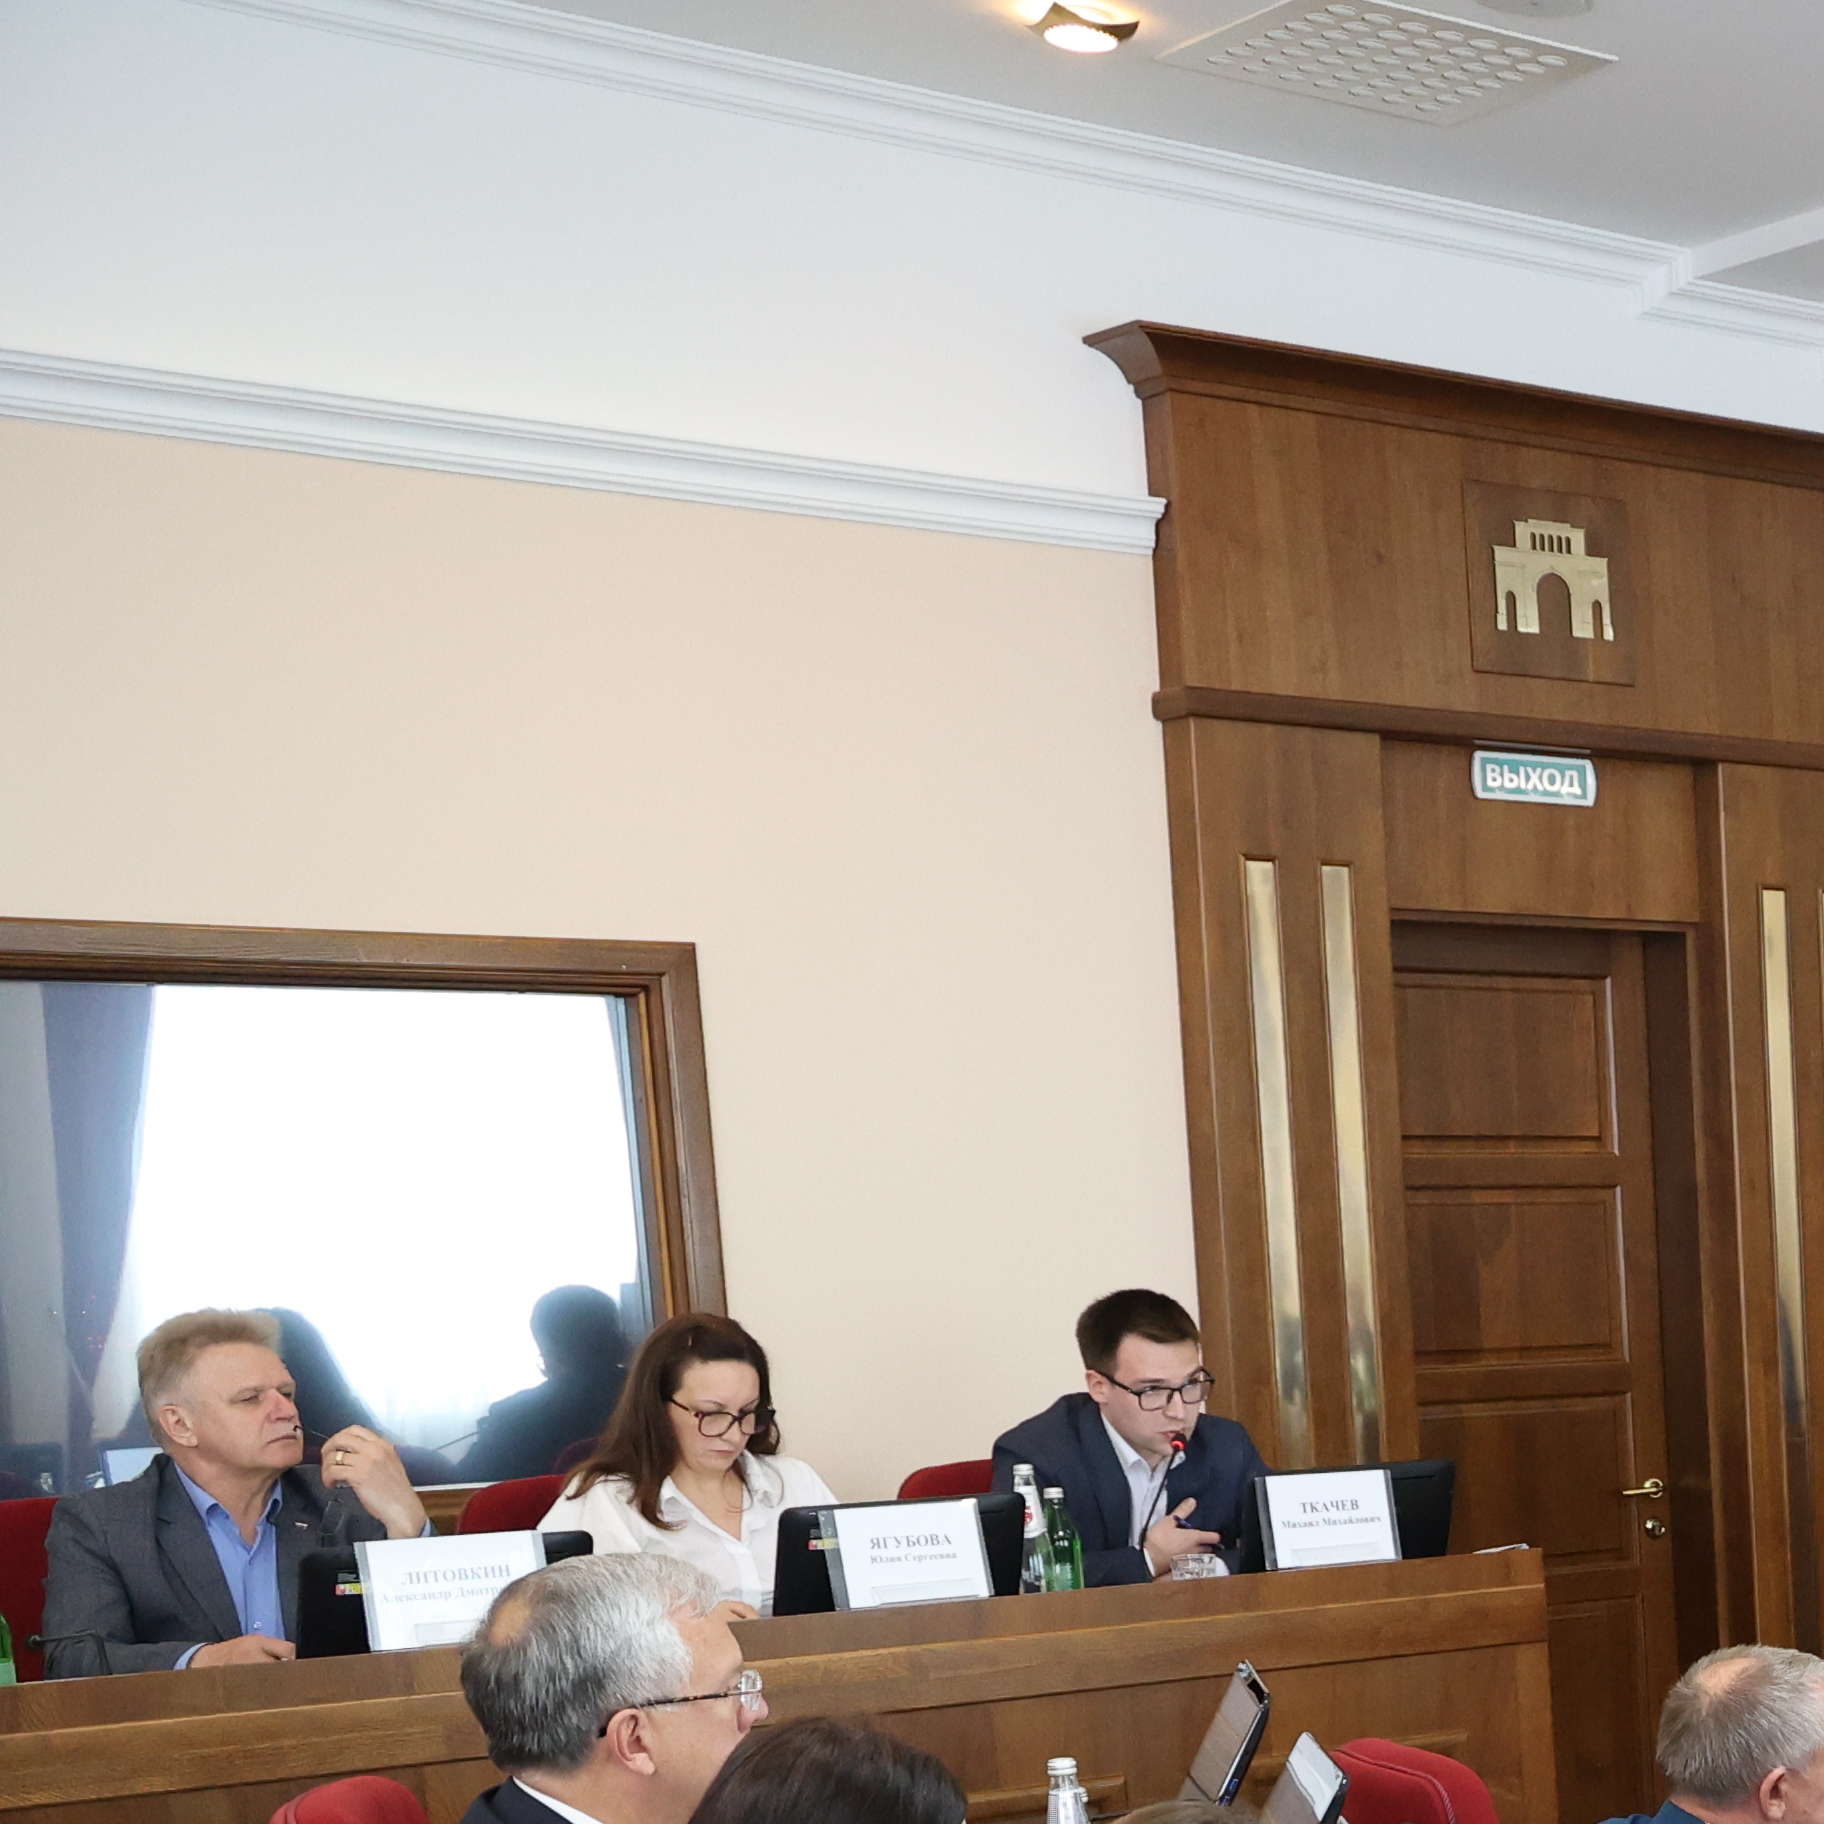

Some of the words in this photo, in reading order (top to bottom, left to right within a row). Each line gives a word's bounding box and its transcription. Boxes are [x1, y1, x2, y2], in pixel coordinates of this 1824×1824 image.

[1485, 763, 1582, 795] ВЫХОД
[1299, 1499, 1359, 1514] ТКАЧЕВ
[870, 1534, 952, 1550] ЯГУБОВА
[401, 1565, 511, 1586] ЛИТОВКИН
